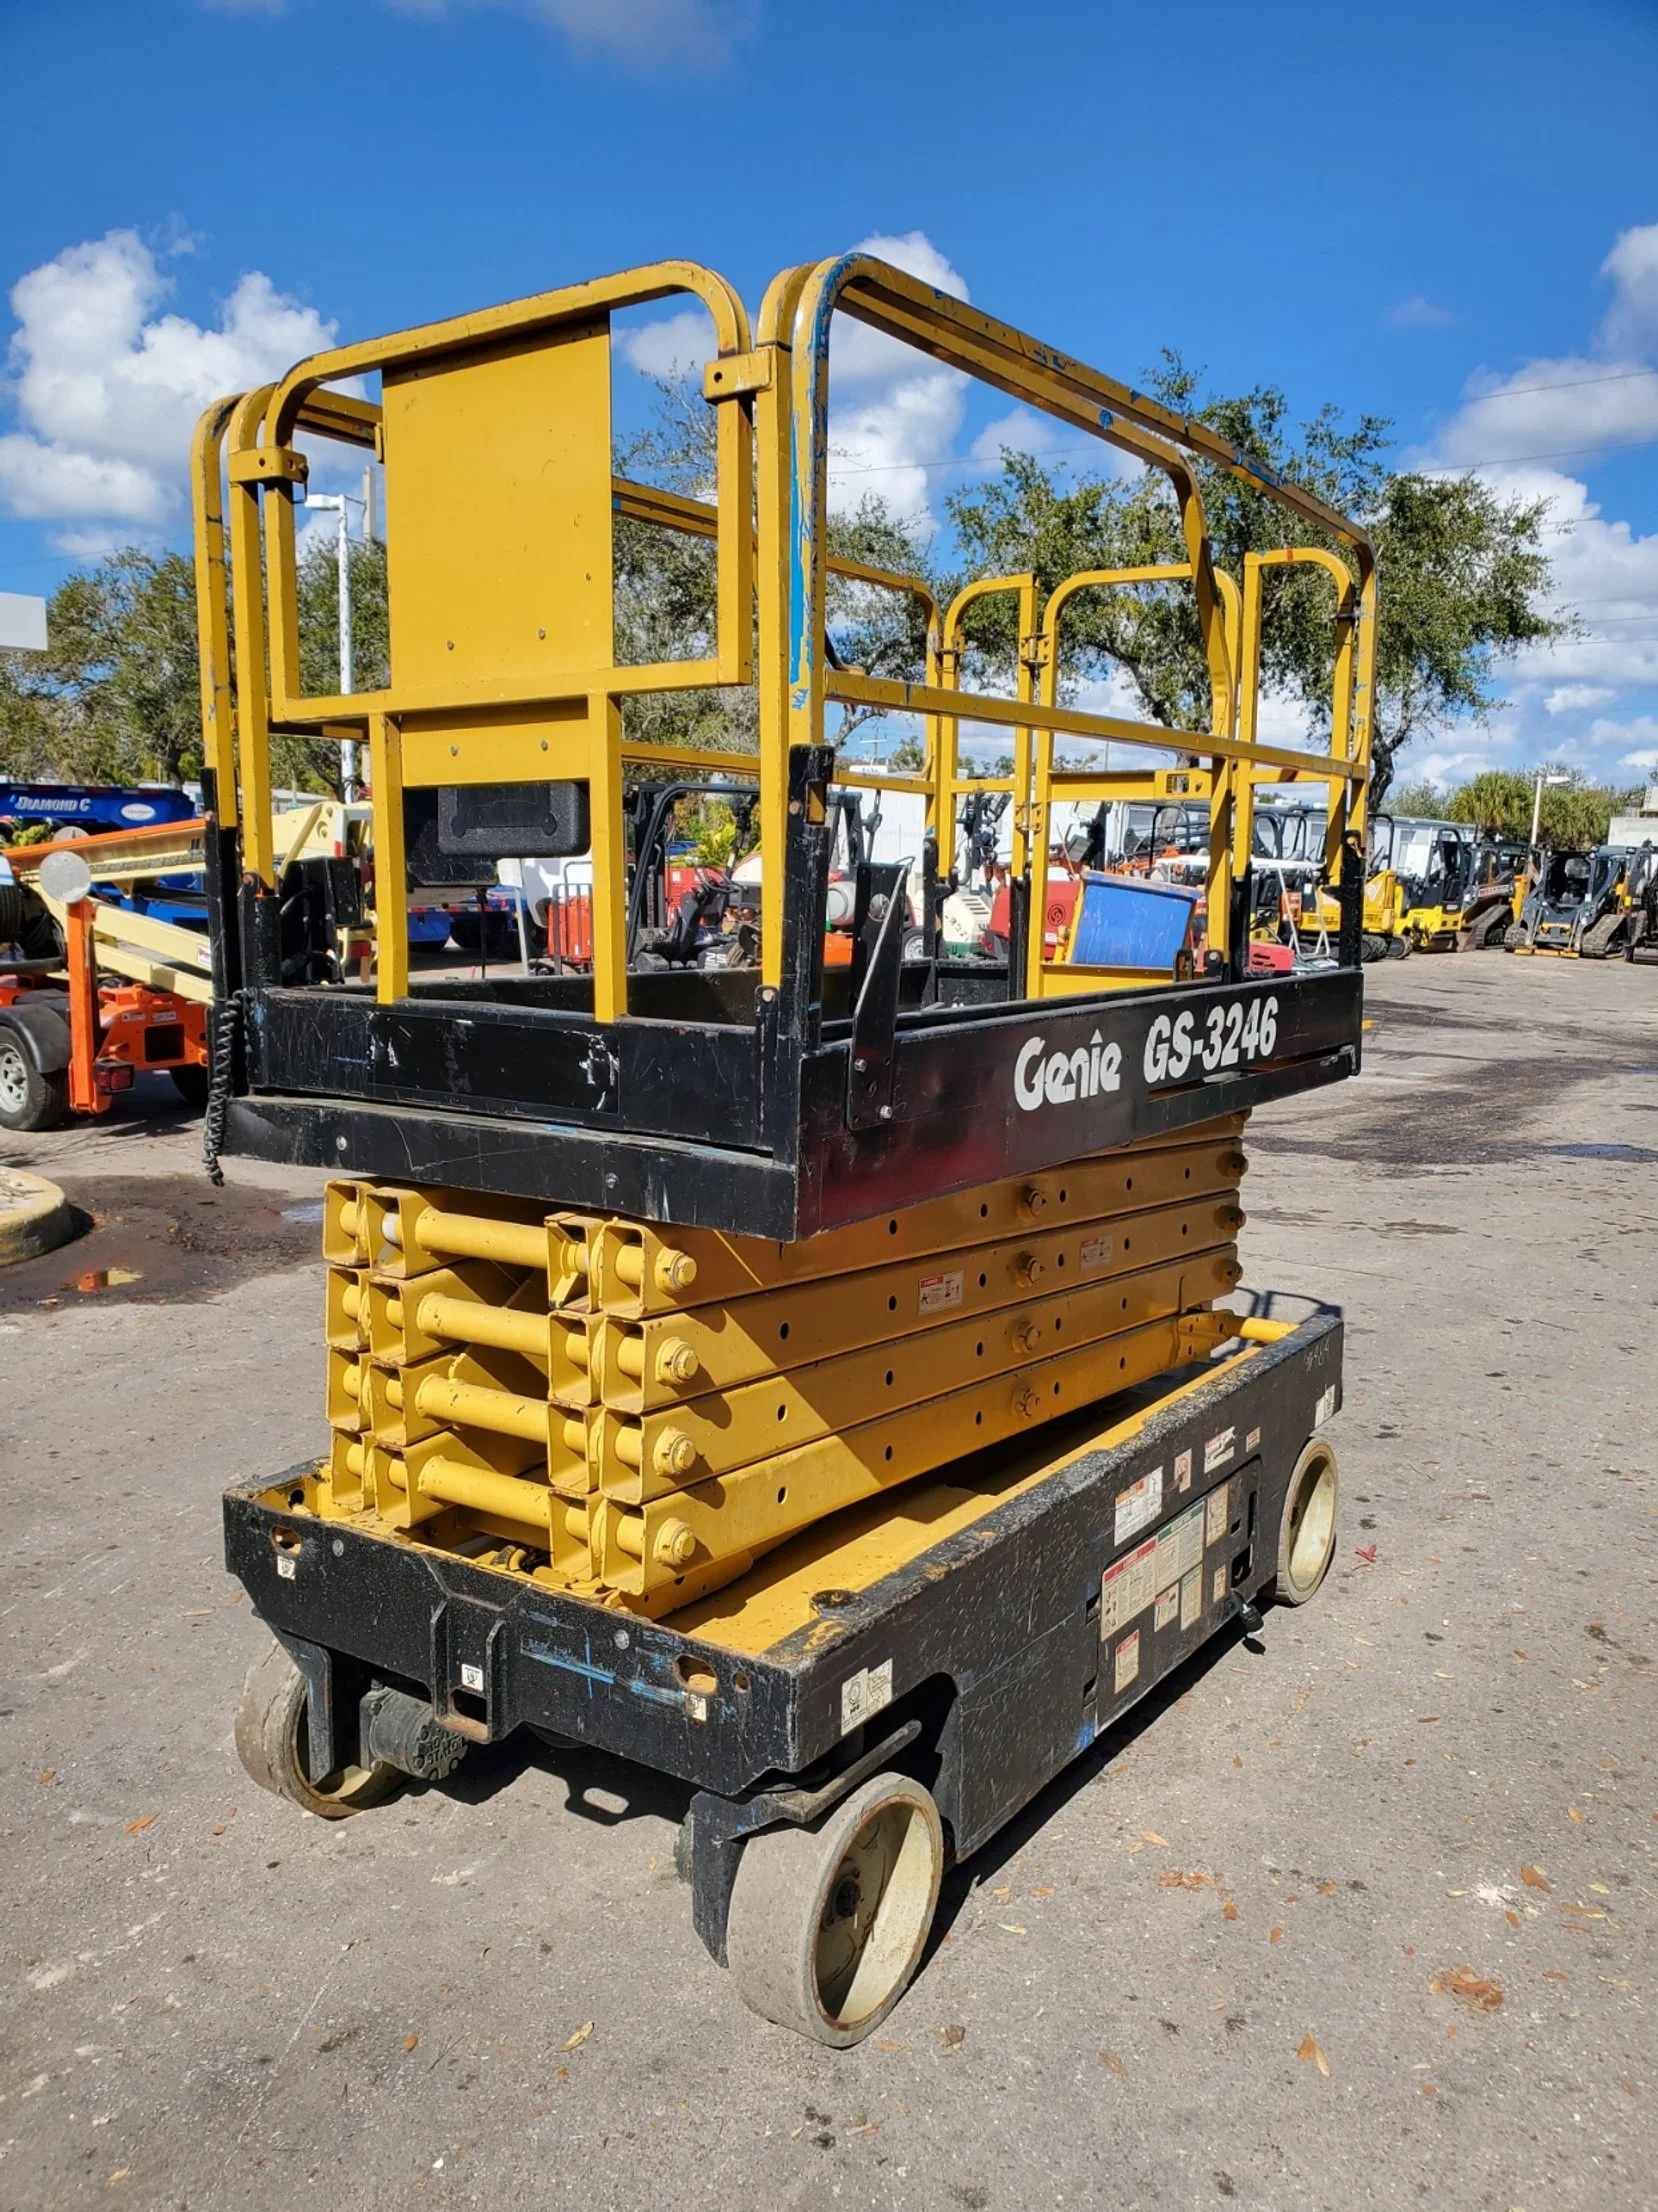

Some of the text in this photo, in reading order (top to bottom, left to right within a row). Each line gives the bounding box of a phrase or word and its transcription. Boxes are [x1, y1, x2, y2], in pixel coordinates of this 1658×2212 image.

[18, 796, 92, 812] DIAMOND C
[1013, 996, 1278, 1111] Genie GS-3246
